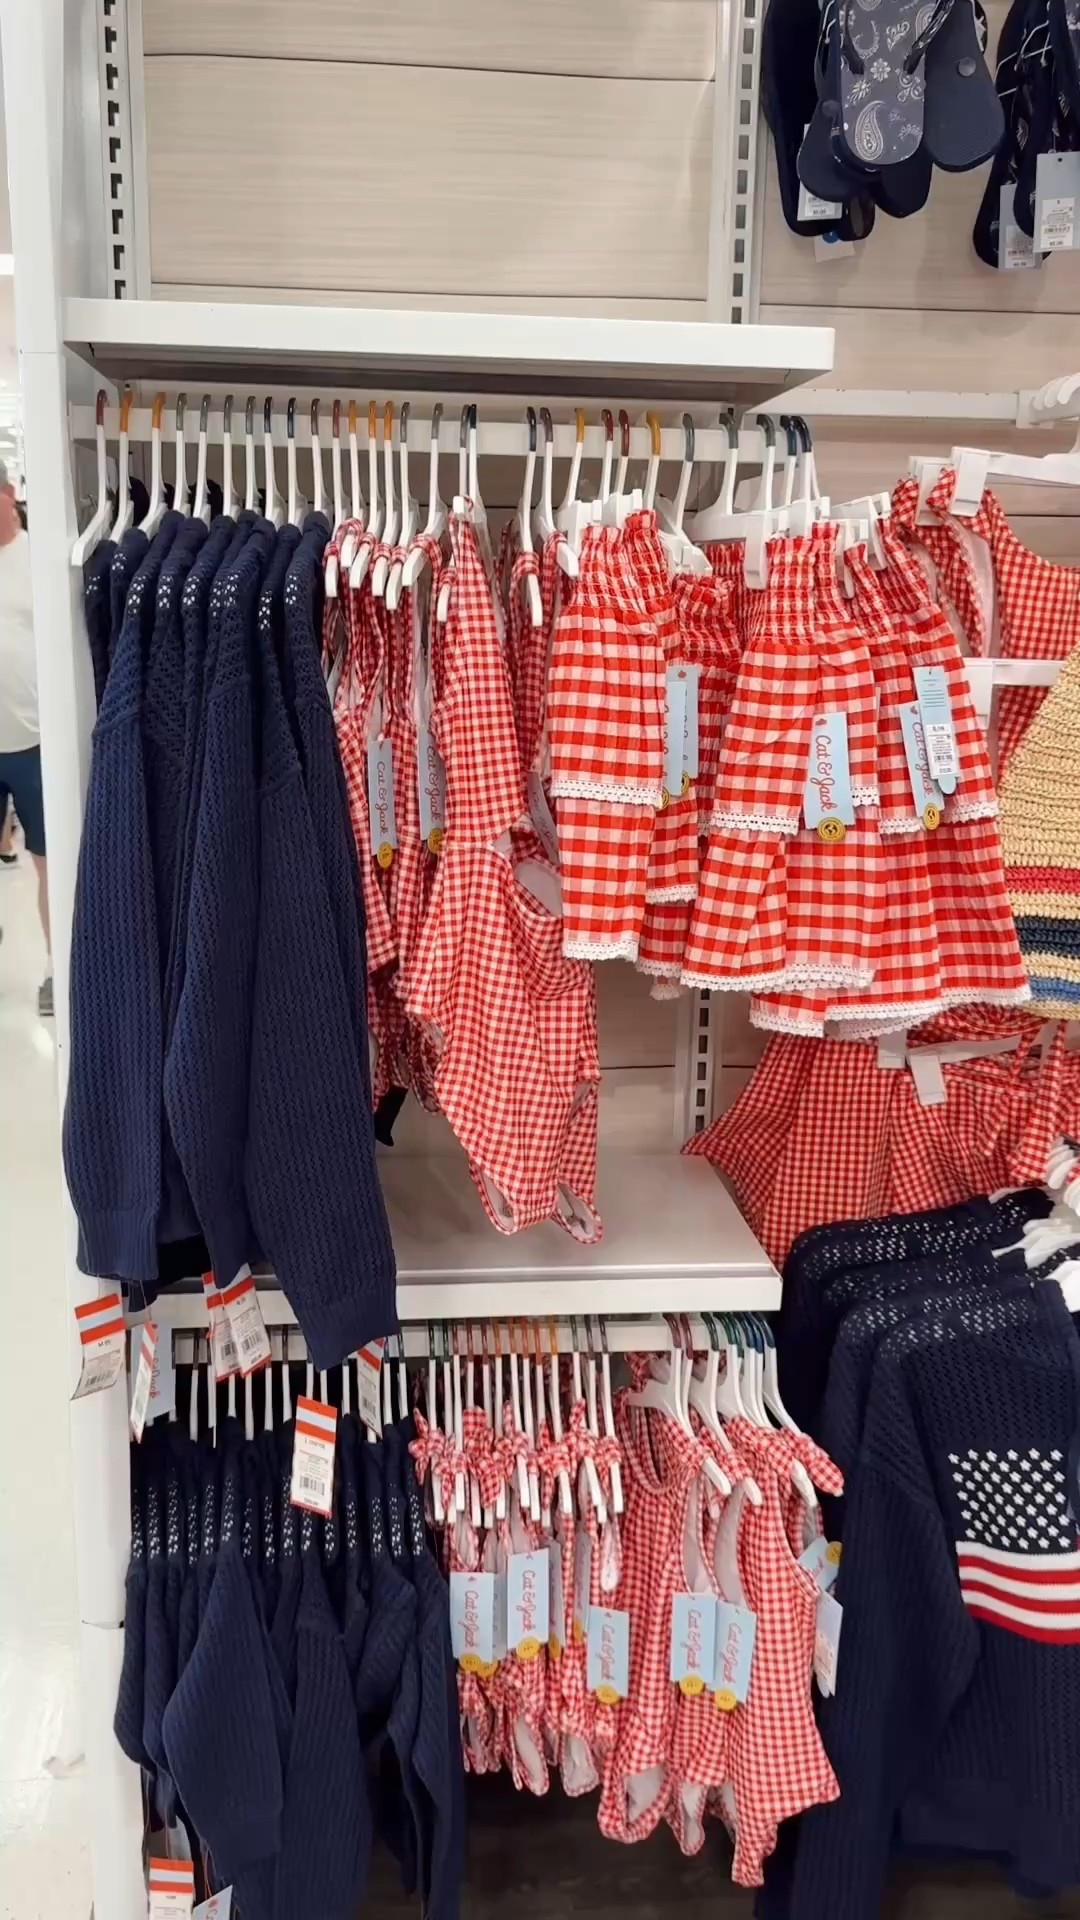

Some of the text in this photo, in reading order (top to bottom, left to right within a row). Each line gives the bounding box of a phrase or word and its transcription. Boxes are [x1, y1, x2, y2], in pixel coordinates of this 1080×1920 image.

[426, 745, 436, 771] Cat
[810, 735, 837, 812] Cat & Jack
[374, 761, 388, 834] Cat & Jack
[424, 786, 441, 821] Jack
[457, 1590, 479, 1649] Cat & Jack
[516, 1569, 536, 1632] Cat & Jack
[680, 1609, 701, 1671] Cat & Jack
[727, 1623, 742, 1643] Cat
[719, 1652, 738, 1683] Jack
